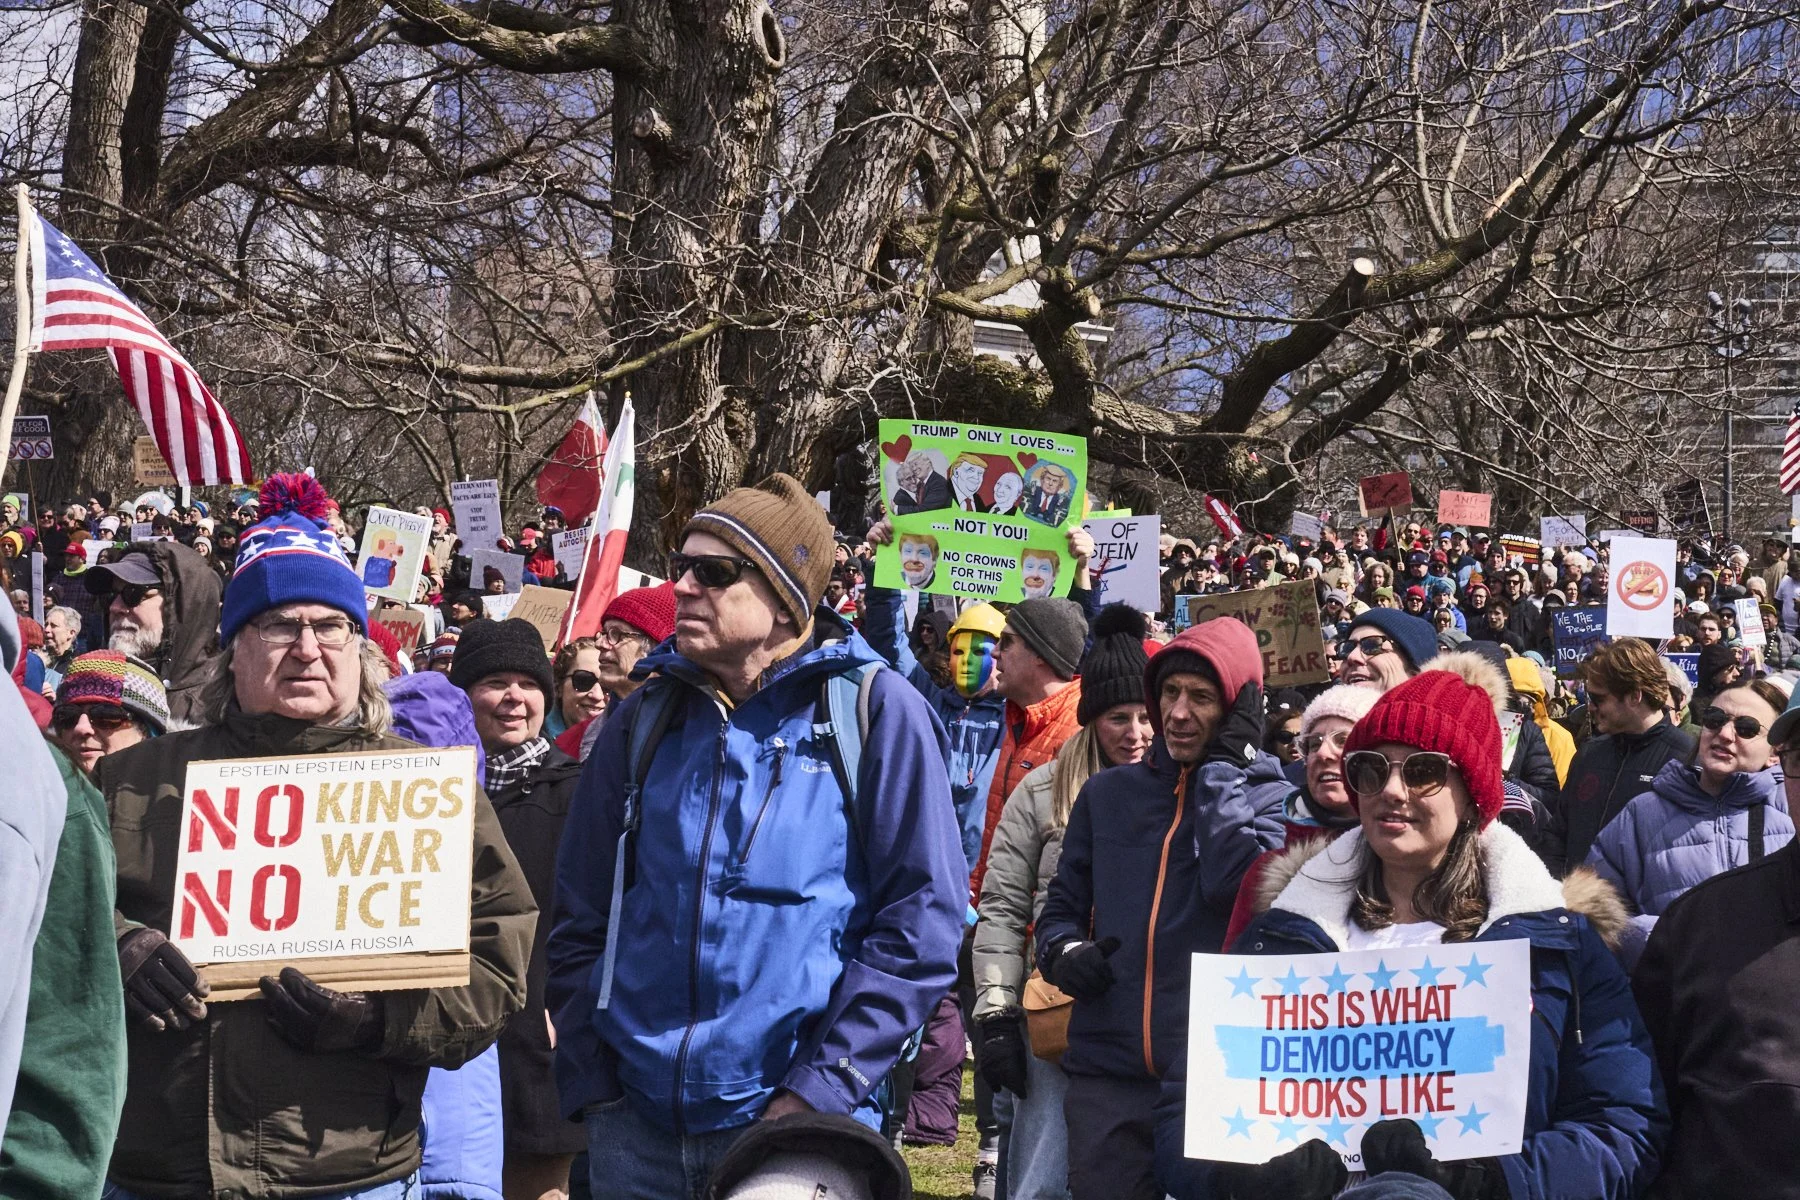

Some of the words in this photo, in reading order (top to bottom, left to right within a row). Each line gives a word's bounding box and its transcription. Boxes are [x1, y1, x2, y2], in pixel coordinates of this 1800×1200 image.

[912, 424, 959, 438] TRUMP
[967, 429, 1003, 443] ONLY
[453, 482, 492, 490] ALTERNATIVE
[369, 510, 396, 527] QUIET
[564, 528, 587, 539] RESIST
[954, 519, 987, 534] NOT
[993, 523, 1028, 541] YOU!
[1111, 522, 1139, 540] OF
[943, 551, 960, 562] NO
[965, 553, 1016, 570] CROWNS
[1091, 542, 1139, 560] STEIN
[950, 566, 974, 578] FOR
[978, 569, 1003, 582] THIS
[952, 581, 998, 595] CLOWN!
[1555, 612, 1571, 626] WE
[1573, 611, 1593, 624] THE
[1263, 650, 1323, 679] FEAR
[1679, 658, 1699, 675] Kin
[219, 764, 290, 778] EPSTEIN
[295, 760, 365, 775] EPSTEIN
[370, 756, 441, 771] EPSTEIN
[187, 783, 305, 853] NO
[315, 776, 464, 824] KINGS
[321, 828, 443, 878] WAR
[179, 864, 301, 940] NO
[335, 880, 423, 931] ICE
[212, 943, 276, 958] RUSSIA
[282, 939, 345, 955] RUSSIA
[351, 935, 414, 951] RUSSIA
[1261, 993, 1330, 1031] THIS
[1337, 991, 1365, 1028] IS
[1370, 984, 1457, 1025] WHAT
[1261, 1026, 1456, 1074] DEMOCRACY
[847, 1065, 871, 1088] GORE-TEX
[1258, 1075, 1367, 1119] LOOKS
[1379, 1070, 1456, 1116] LIKE
[1344, 1154, 1361, 1163] NO
